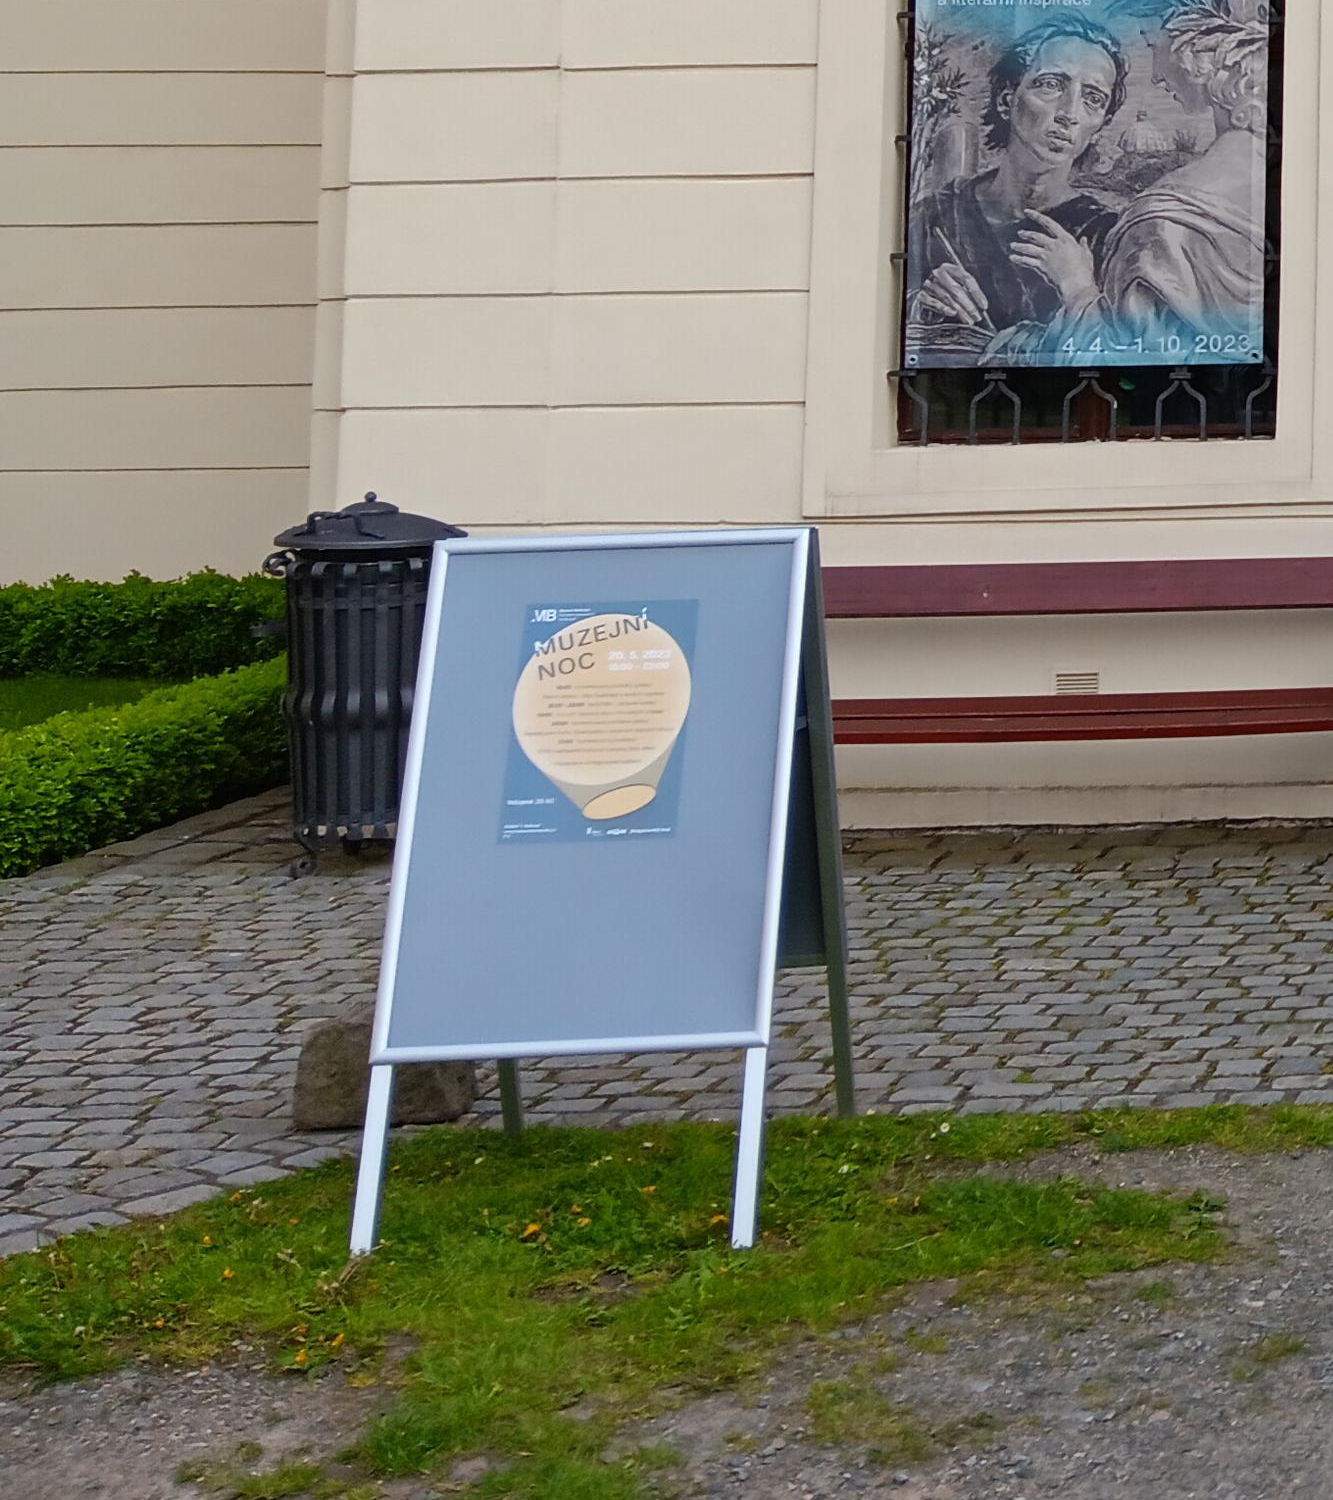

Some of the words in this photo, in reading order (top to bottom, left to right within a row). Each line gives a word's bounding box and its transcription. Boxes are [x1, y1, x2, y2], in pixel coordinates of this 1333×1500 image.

[1061, 337, 1082, 355] 4.
[1089, 337, 1109, 354] 4.
[1157, 335, 1187, 354] 10.
[1195, 334, 1250, 353] 2023
[534, 607, 650, 658] MUZEJNÍ
[537, 652, 596, 681] NOC
